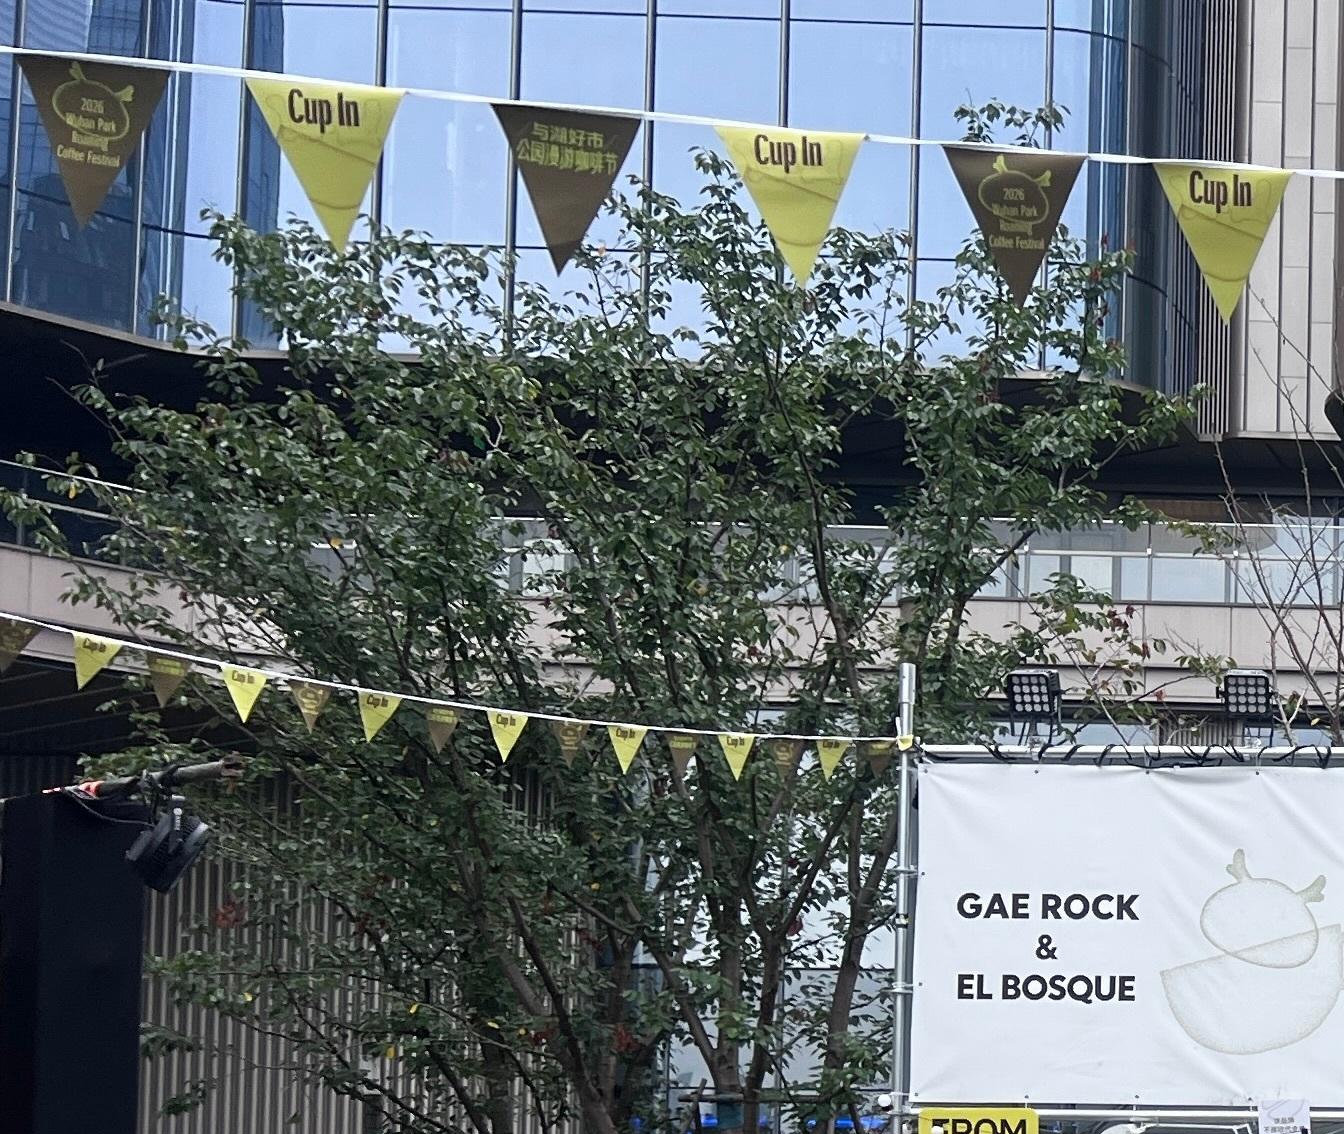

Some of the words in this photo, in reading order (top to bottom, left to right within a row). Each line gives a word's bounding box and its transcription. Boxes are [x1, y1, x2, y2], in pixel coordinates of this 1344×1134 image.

[97, 117, 117, 133] Park
[287, 88, 331, 134] Cup
[337, 92, 361, 128] In
[753, 134, 797, 174] Cup
[801, 136, 823, 167] In
[1189, 170, 1228, 214] Cup
[1233, 174, 1252, 207] In
[1020, 204, 1038, 217] Park
[956, 892, 1030, 921] GAE
[1041, 893, 1139, 921] ROCK
[1035, 934, 1058, 960] &
[957, 974, 993, 1000] EL
[1002, 974, 1136, 1004] BOSQUE
